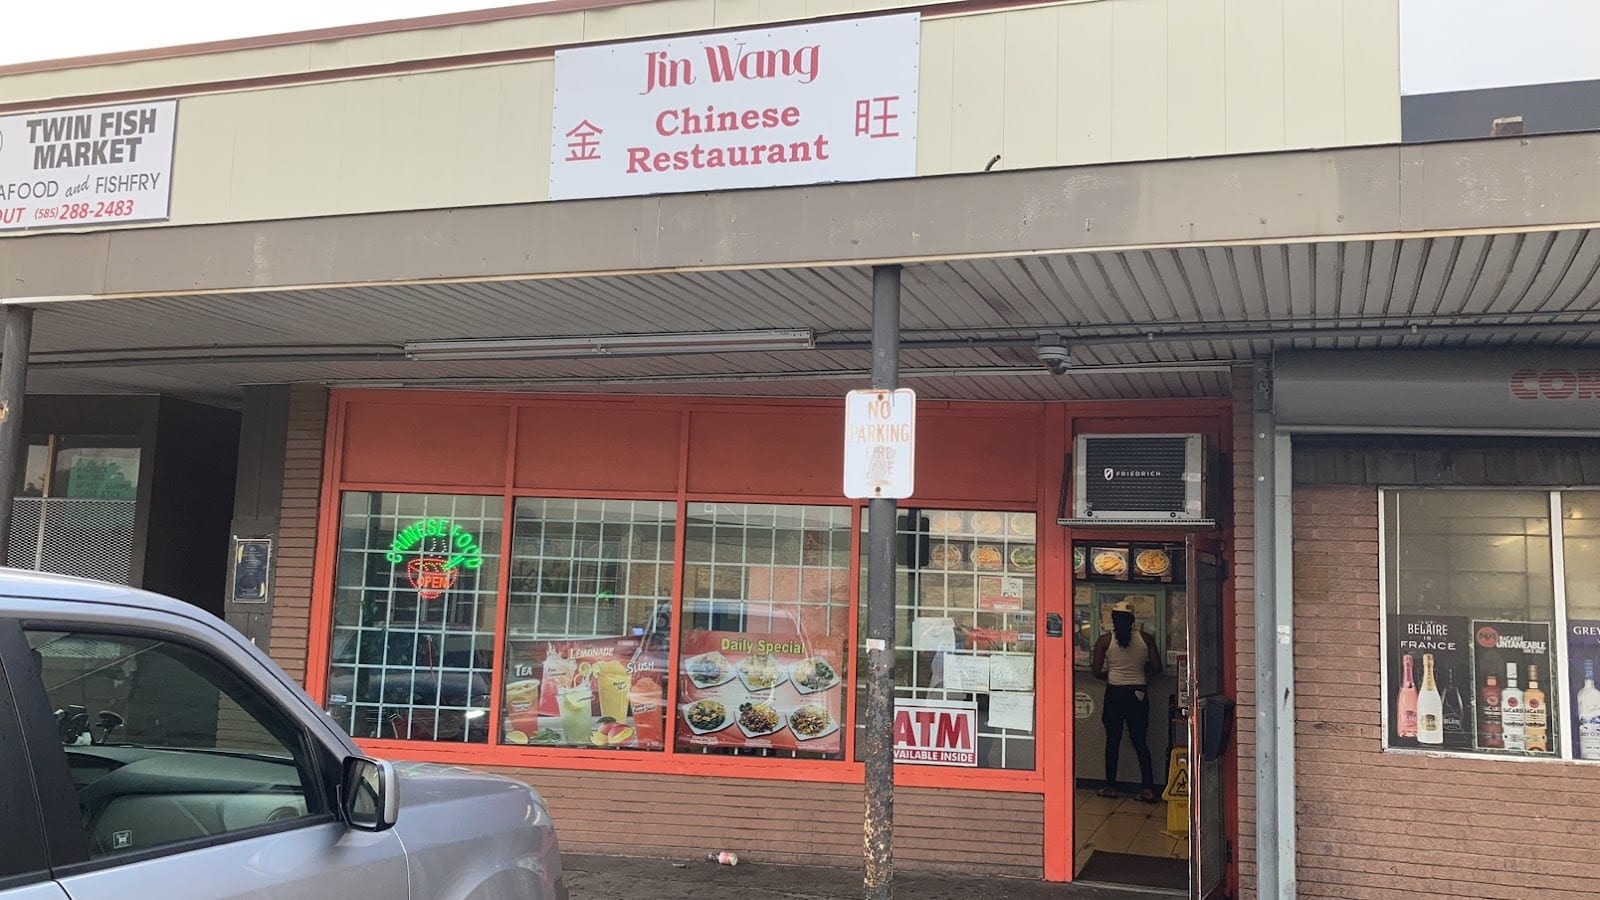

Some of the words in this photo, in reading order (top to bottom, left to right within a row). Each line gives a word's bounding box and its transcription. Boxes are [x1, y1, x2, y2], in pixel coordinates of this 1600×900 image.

[639, 51, 697, 95] Jin
[703, 42, 822, 85] Wang
[26, 114, 92, 144] TWIN
[100, 108, 157, 137] FISH
[655, 105, 801, 137] Chinese
[855, 96, 900, 139] 旺
[565, 119, 604, 162] 金
[33, 137, 142, 170] MARKET
[625, 134, 829, 174] Restaurant
[65, 174, 90, 198] and
[96, 172, 161, 194] FISHFRY
[868, 400, 891, 420] NO
[850, 424, 910, 444] PARKING
[1115, 470, 1161, 478] FRIEDRICH
[386, 517, 449, 564] CHINESE
[450, 523, 483, 569] FOOD
[417, 575, 450, 589] OPEN
[1407, 623, 1448, 636] BELAIRE
[721, 637, 754, 654] Daily
[758, 639, 806, 655] Special
[1400, 640, 1456, 651] FRANCE
[1496, 639, 1547, 650] UNTAMEABLE
[514, 664, 533, 677] TEA
[893, 710, 971, 750] ATM
[940, 751, 974, 763] INSIDE
